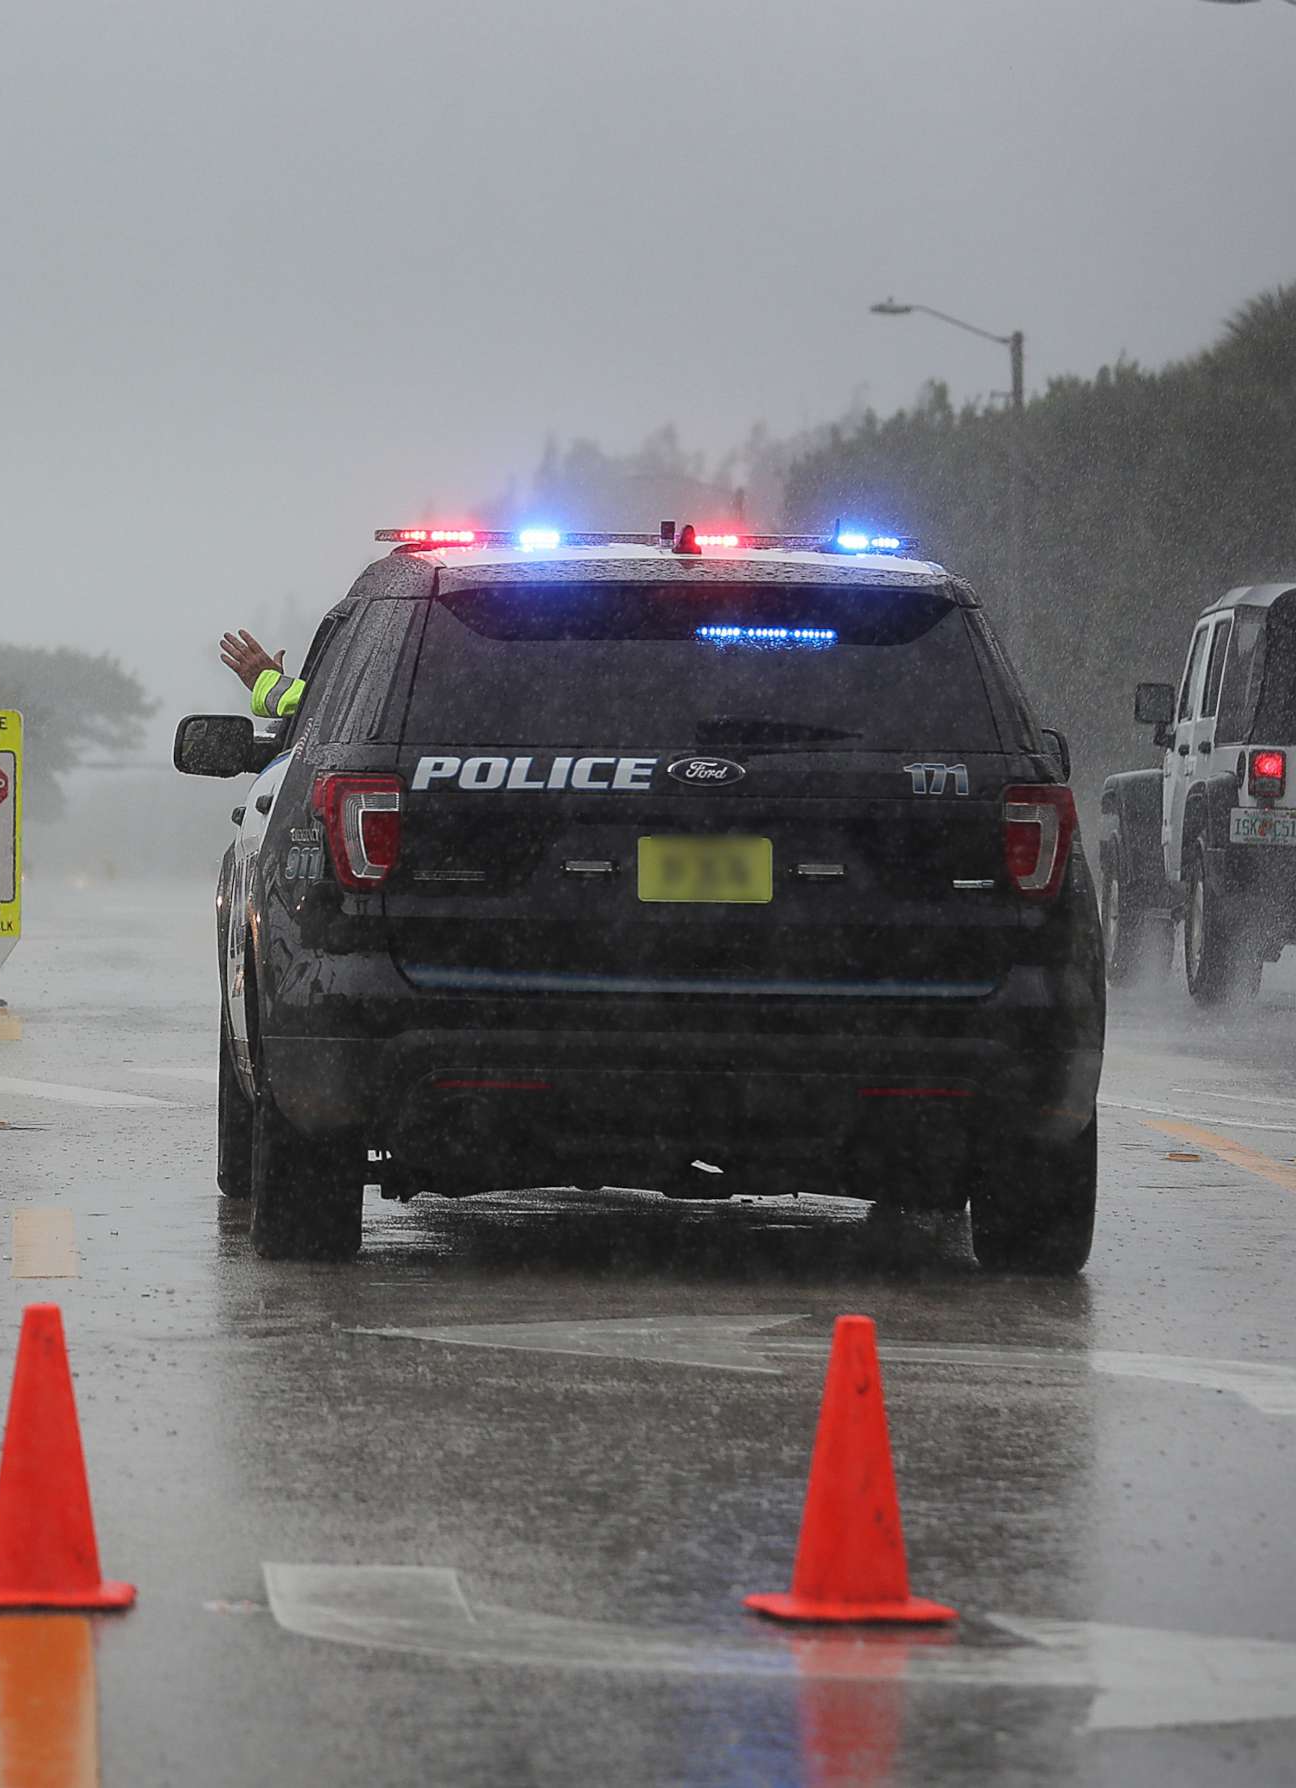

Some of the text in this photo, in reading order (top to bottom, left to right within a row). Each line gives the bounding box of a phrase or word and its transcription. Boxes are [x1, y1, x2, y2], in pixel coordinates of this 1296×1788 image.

[410, 756, 659, 790] POLICE
[685, 761, 728, 780] Ford
[903, 763, 969, 796] 171
[285, 846, 320, 880] 911
